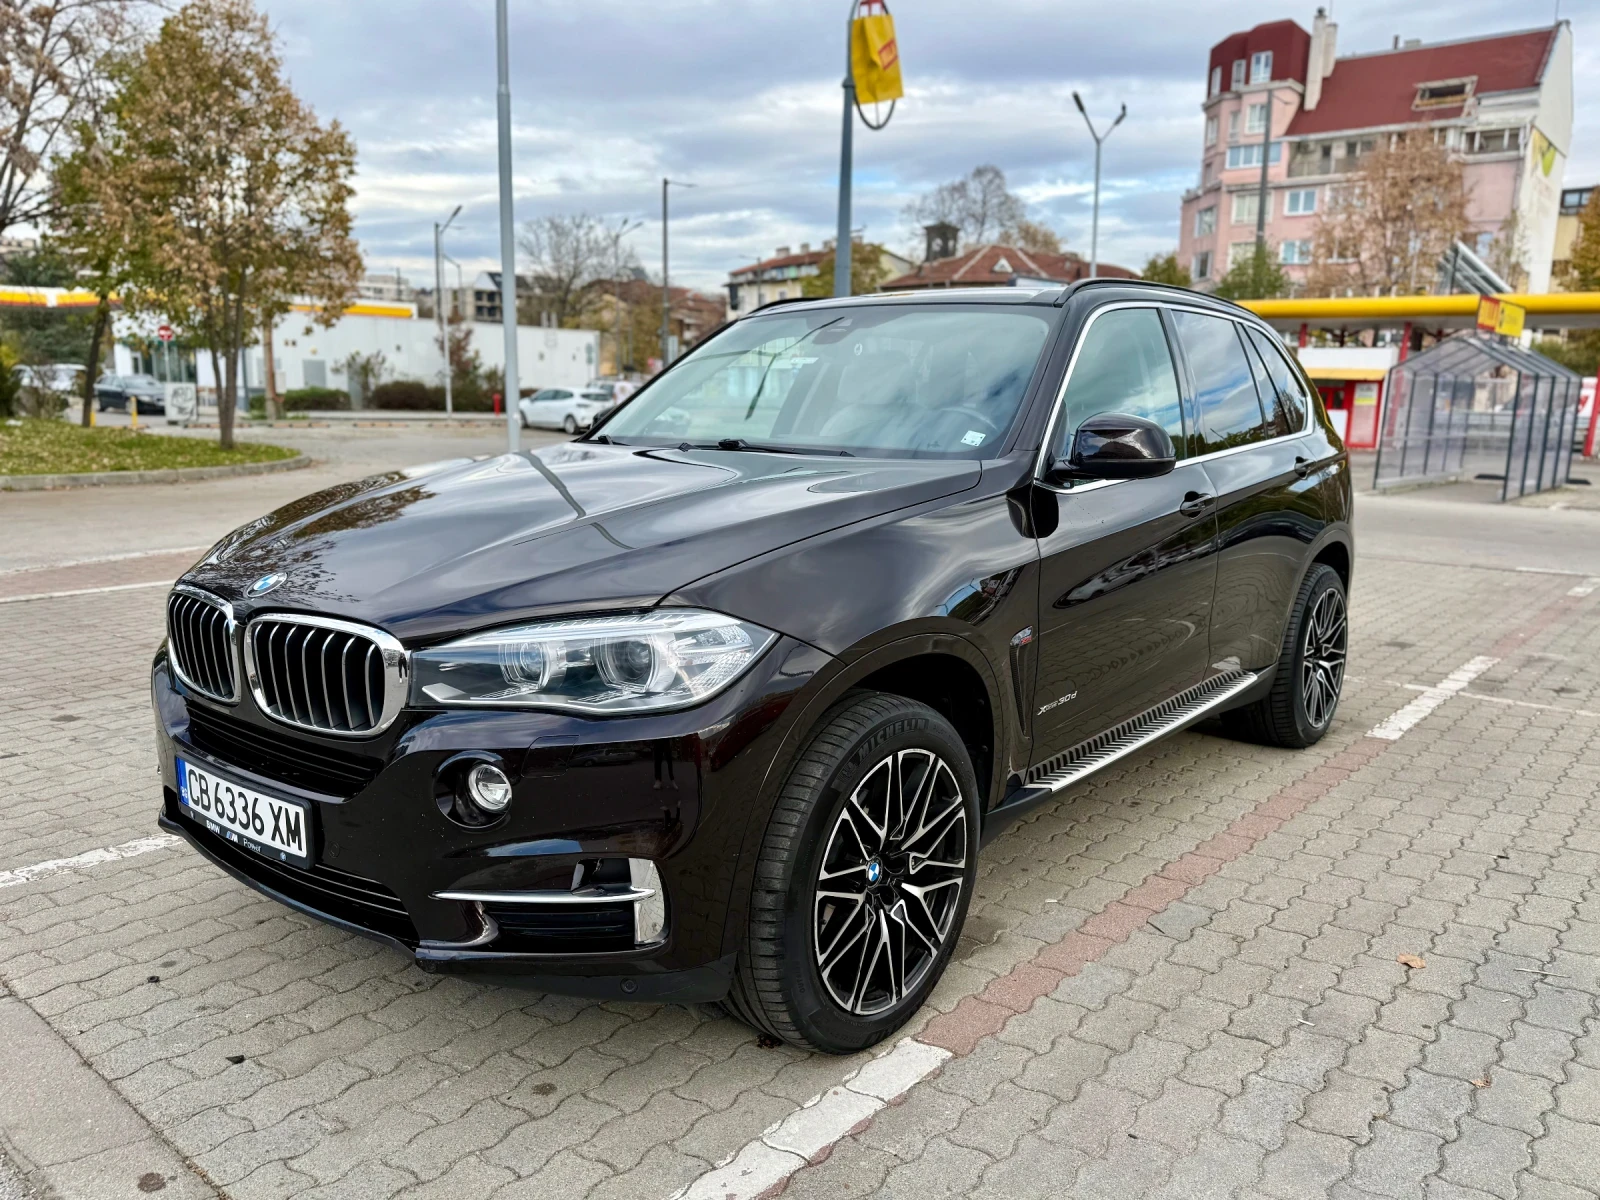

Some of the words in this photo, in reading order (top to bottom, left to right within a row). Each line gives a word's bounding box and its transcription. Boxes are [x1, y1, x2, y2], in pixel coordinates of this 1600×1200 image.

[858, 717, 929, 760] MICHELIN
[188, 769, 211, 812] CB
[214, 782, 265, 836] 6336
[269, 802, 303, 852] XM
[206, 820, 221, 834] BMW
[243, 838, 262, 853] Power
